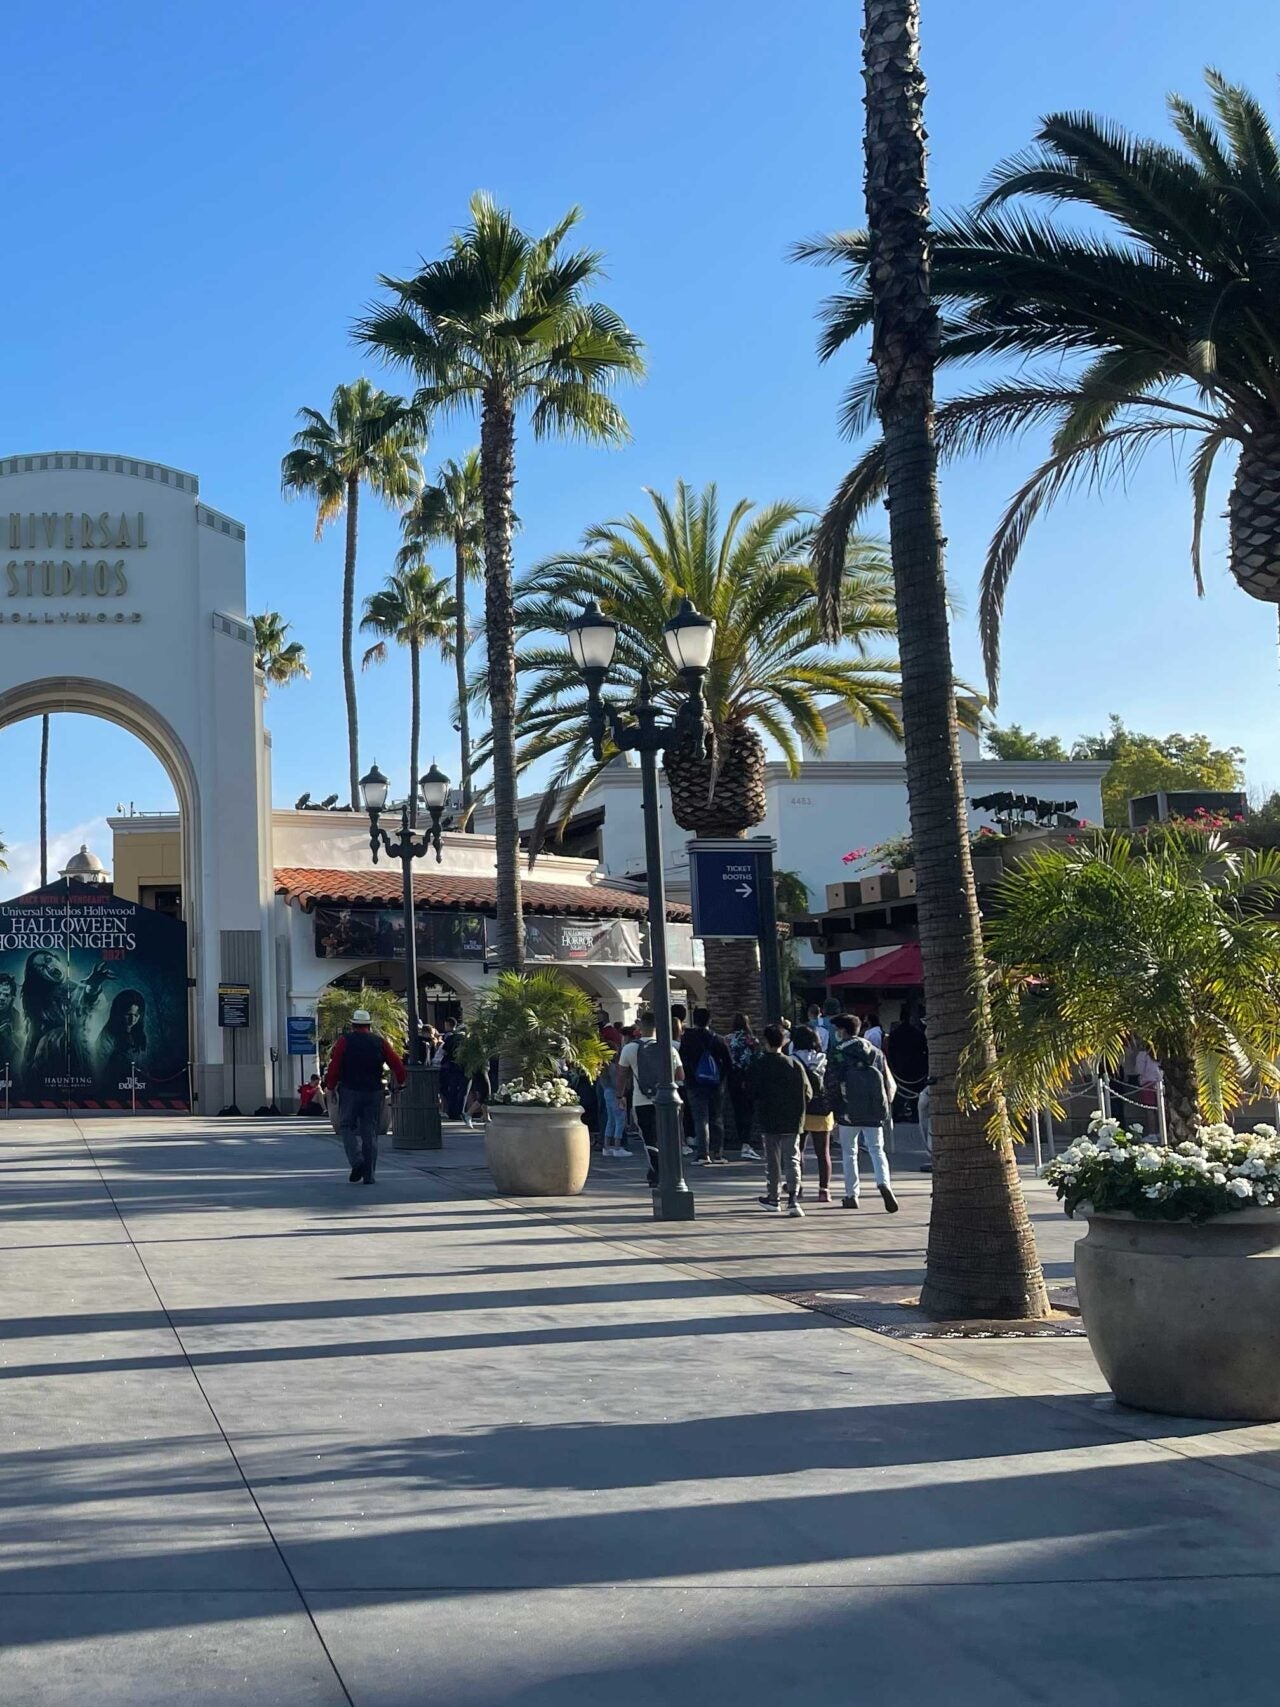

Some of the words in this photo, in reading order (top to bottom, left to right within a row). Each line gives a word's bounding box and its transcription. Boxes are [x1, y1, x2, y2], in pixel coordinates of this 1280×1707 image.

[6, 559, 128, 597] STUDIOS
[722, 873, 753, 881] BOOTHS
[1, 906, 43, 917] Universal
[45, 905, 81, 916] Studios
[83, 906, 136, 918] Hollywood
[11, 917, 127, 934] HALLOWEEN
[70, 933, 136, 951] NIGHTS
[561, 935, 594, 947] HORROR
